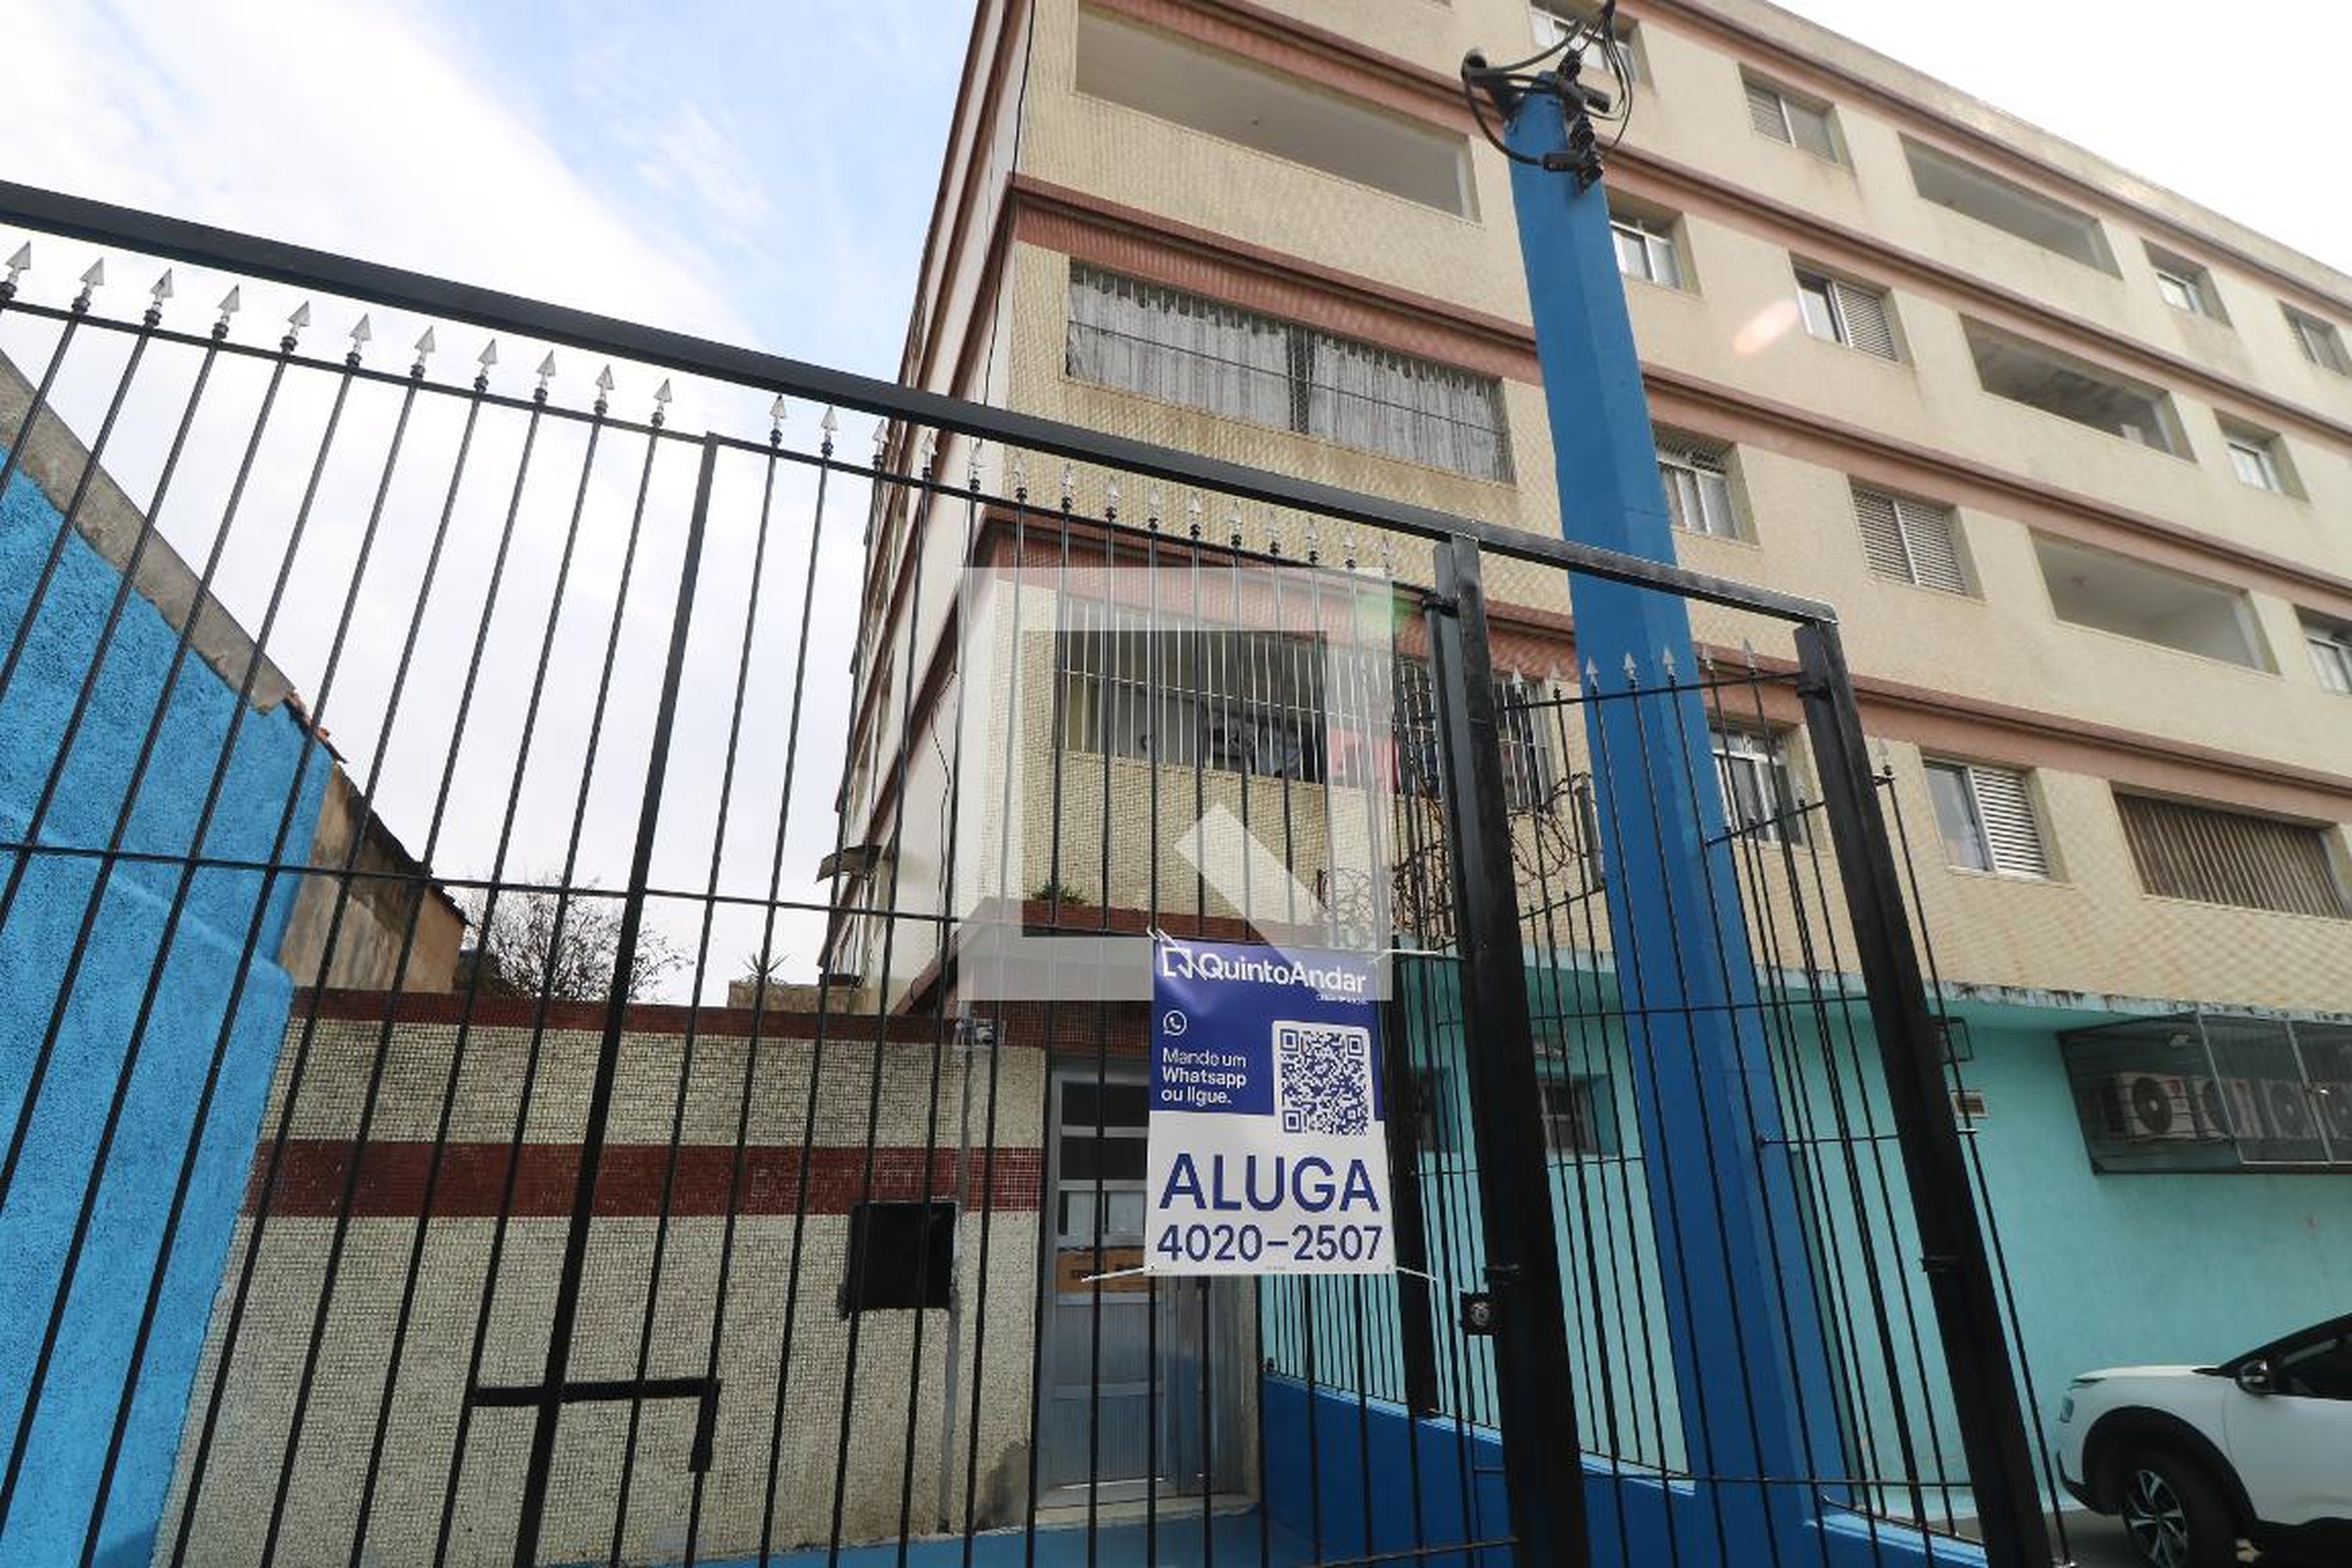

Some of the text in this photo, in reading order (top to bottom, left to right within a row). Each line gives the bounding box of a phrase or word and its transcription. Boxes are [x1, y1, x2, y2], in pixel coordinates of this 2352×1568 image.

[1198, 952, 1367, 993] QuintoAndar
[1163, 1047, 1247, 1069] Mande um
[1161, 1065, 1247, 1089] Whatsapp
[1161, 1086, 1232, 1107] ou ligue.
[1159, 1152, 1380, 1213] ALUGA
[1157, 1223, 1383, 1262] 4020-2507
